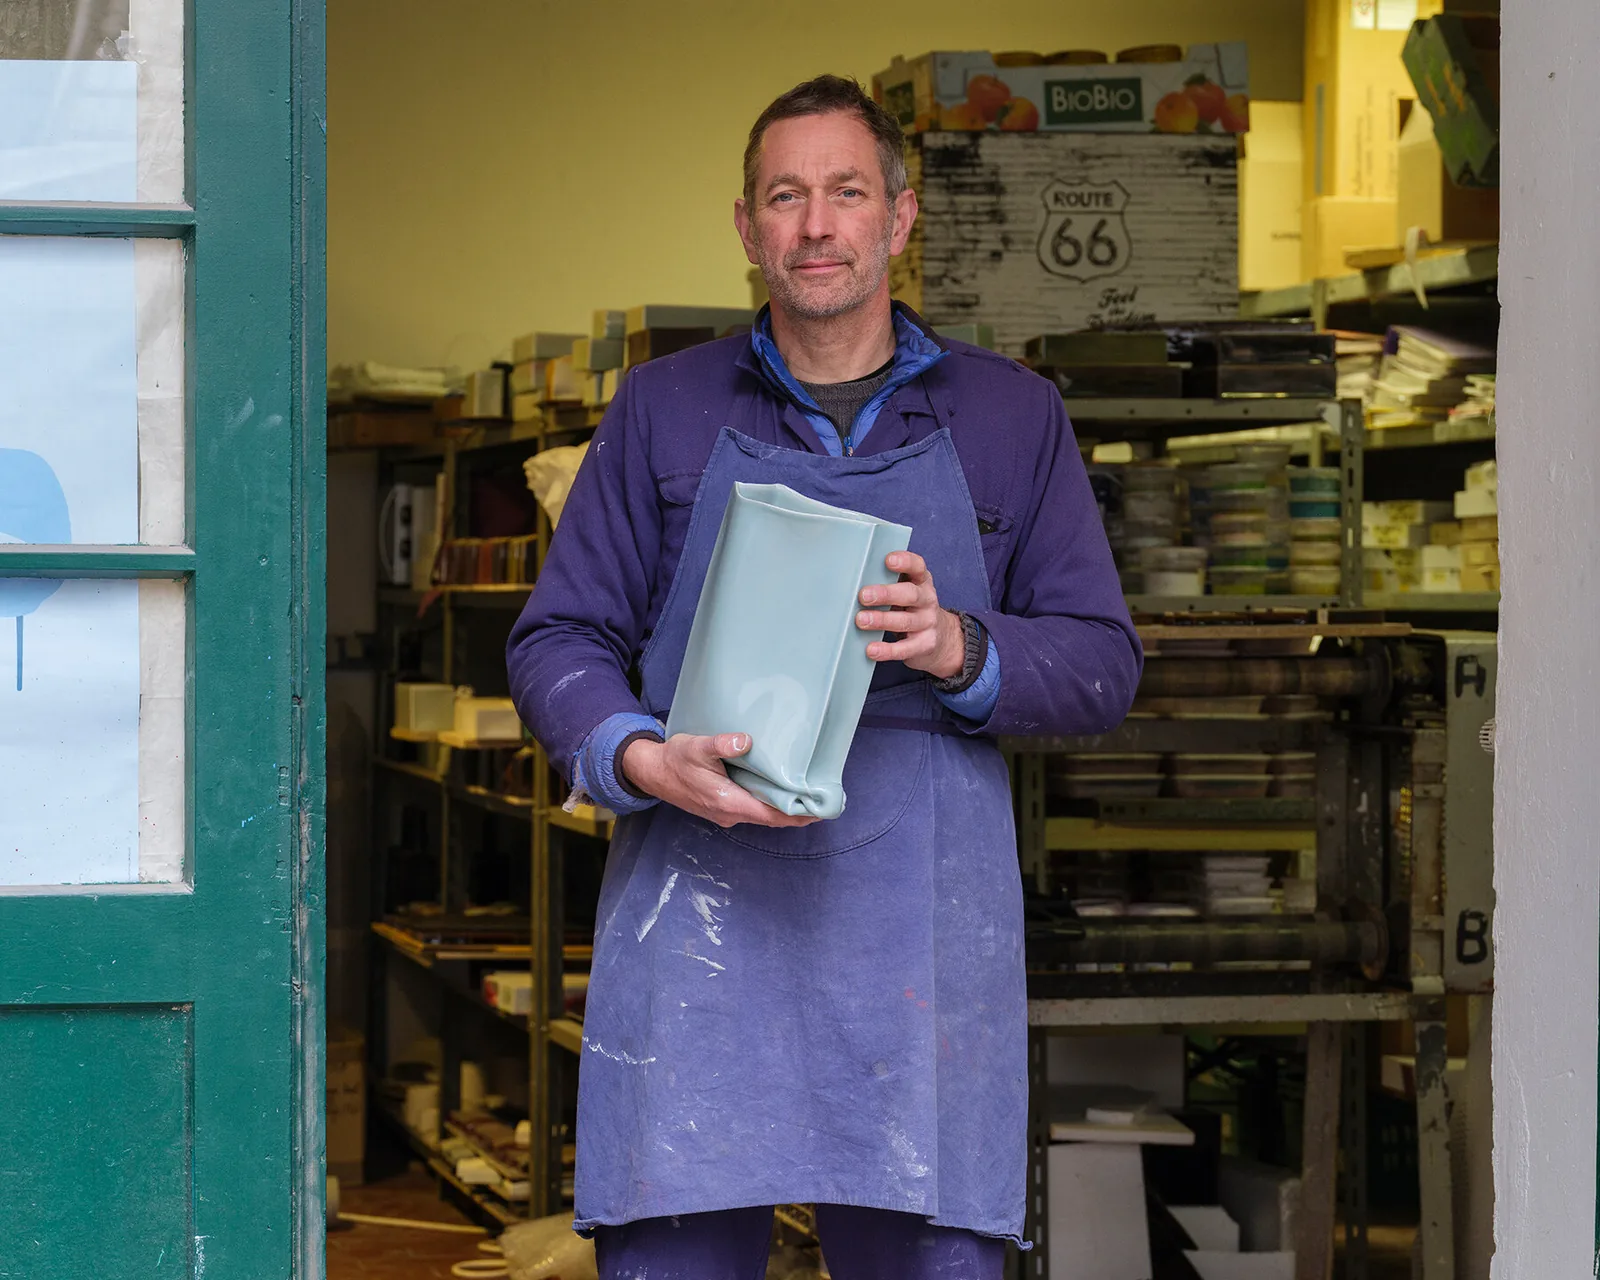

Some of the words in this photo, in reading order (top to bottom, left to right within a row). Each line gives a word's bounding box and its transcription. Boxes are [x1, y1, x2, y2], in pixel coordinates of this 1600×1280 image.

[1053, 191, 1113, 208] ROUTE
[1051, 218, 1117, 267] 66
[1455, 655, 1486, 698] A
[1457, 908, 1488, 966] B
